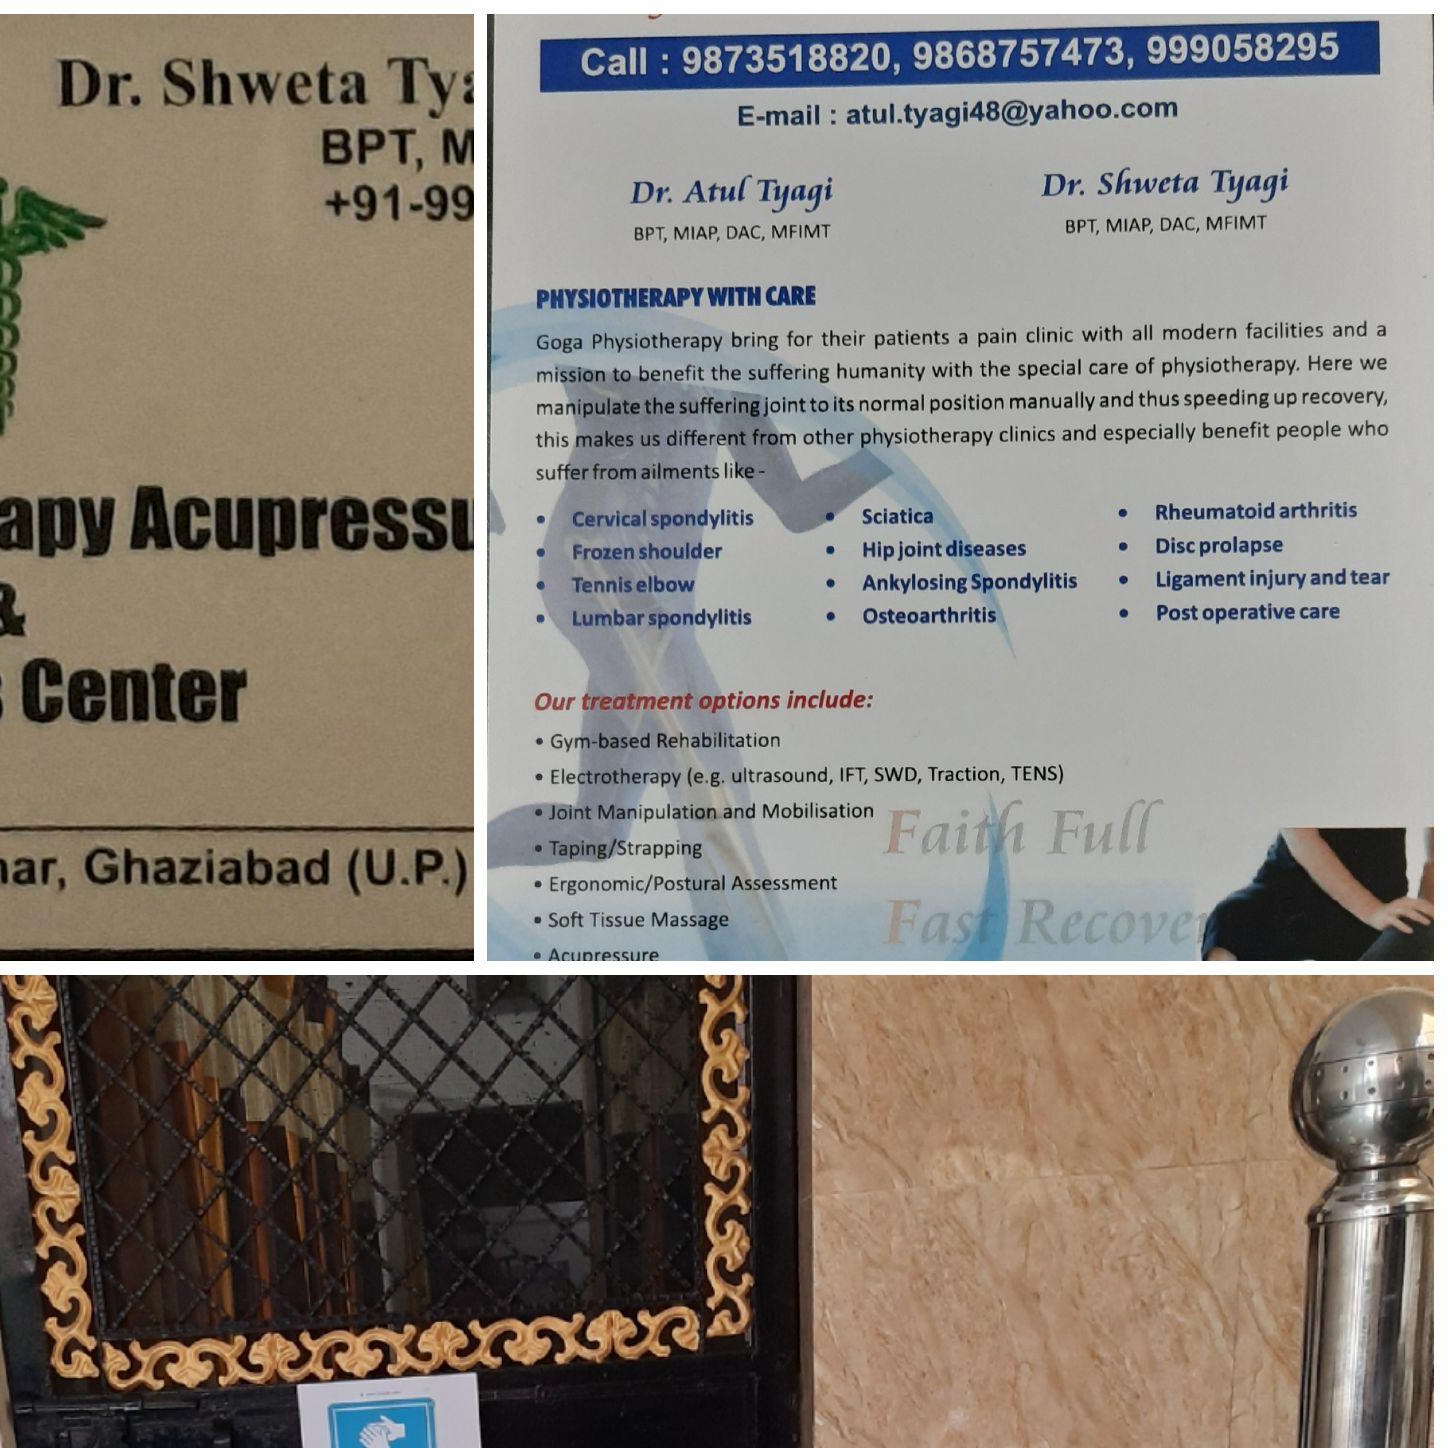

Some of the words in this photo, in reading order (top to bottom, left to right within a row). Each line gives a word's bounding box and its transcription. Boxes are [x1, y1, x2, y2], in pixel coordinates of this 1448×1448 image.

[581, 46, 646, 78] Call
[680, 41, 900, 76] 9873518820,
[913, 35, 1135, 70] 9868757473,
[1145, 30, 1339, 64] 999058295
[57, 59, 141, 107] Dr.
[163, 58, 369, 107] Shweta
[738, 104, 820, 127] E-mail
[846, 98, 1178, 129] atul.tyagi48@yahoo.com
[322, 128, 423, 173] BPT,
[630, 181, 672, 204] Dr.
[682, 174, 753, 203] Atul
[757, 176, 833, 214] Tyagi
[1041, 174, 1084, 197] Dr.
[1097, 167, 1199, 196] Shweta
[1211, 167, 1288, 203] Tyagi
[325, 184, 474, 222] +91-99
[634, 226, 667, 243] BPT,
[674, 224, 720, 243] MIAP,
[726, 224, 765, 242] DAC,
[772, 224, 831, 239] MFIMT
[1066, 217, 1099, 236] BPT,
[1106, 216, 1153, 235] MIAP,
[1160, 216, 1200, 234] DAC,
[1206, 214, 1267, 231] MFIMT
[537, 287, 704, 309] PHYSIOTHERAPY
[707, 286, 761, 307] WITH
[765, 285, 816, 306] CARE
[537, 334, 583, 354] Goga
[592, 332, 724, 353] Physiotherapy
[732, 331, 779, 351] bring
[786, 330, 813, 349] for
[820, 330, 866, 349] their
[872, 329, 949, 350] patients
[954, 332, 968, 345] a
[978, 328, 1017, 348] pain
[1026, 326, 1074, 343] clinic
[1082, 324, 1122, 344] with
[1132, 324, 1153, 344] all
[1160, 323, 1237, 344] modern
[1245, 322, 1324, 339] facilities
[1333, 320, 1367, 337] and
[1376, 325, 1387, 337] a
[536, 462, 590, 482] suffer
[592, 463, 637, 481] from
[641, 463, 720, 480] ailments
[723, 462, 755, 480] like
[573, 509, 648, 528] Cervical
[651, 508, 754, 530] spondylitis
[862, 507, 934, 525] Sciatica
[1156, 501, 1275, 520] Rheumatoid
[1279, 501, 1357, 519] arthritis
[573, 544, 635, 562] Frozen
[639, 542, 723, 560] shoulder
[863, 541, 895, 562] Hip
[897, 540, 942, 561] joint
[946, 539, 1026, 561] diseases
[1156, 537, 1196, 554] Disc
[1199, 536, 1284, 557] prolapse
[571, 576, 632, 594] Tennis
[636, 575, 695, 593] elbow
[862, 573, 968, 595] Ankylosing
[970, 572, 1078, 594] Spondylitis
[1157, 570, 1247, 591] Ligament
[1250, 569, 1307, 590] injury
[1310, 568, 1346, 586] and
[1350, 570, 1390, 585] tear
[573, 608, 645, 627] Lumbar
[648, 607, 752, 630] spondylitis
[863, 605, 998, 624] Osteoarthritis
[1157, 604, 1198, 621] Post
[1202, 603, 1296, 624] operative
[1299, 606, 1340, 619] care
[21, 657, 248, 725] Center
[535, 692, 576, 711] Our
[582, 692, 694, 711] treatment
[697, 690, 781, 714] options
[787, 689, 873, 709] include:
[550, 732, 651, 753] Gym-based
[656, 731, 782, 748] Rehabilitation
[551, 768, 681, 788] Electrotherapy
[687, 767, 725, 787] (e.g.
[731, 766, 836, 785] ultrasound,
[840, 767, 868, 785] IFT,
[872, 765, 922, 785] SWD,
[928, 766, 1005, 784] Traction,
[1010, 764, 1063, 784] TENS)
[549, 804, 592, 820] Joint
[598, 803, 719, 823] Manipulation
[722, 802, 756, 819] and
[761, 801, 875, 820] Mobilisation
[883, 800, 1026, 855] Faith
[1047, 799, 1164, 855] Full
[548, 838, 702, 862] Taping/Strapping
[84, 846, 330, 887] Ghaziabad
[348, 843, 471, 901] (U.P.)
[550, 874, 725, 896] Ergonomic/Postural
[731, 874, 837, 893] Assessment
[548, 911, 584, 928] Soft
[589, 912, 647, 928] Tissue
[649, 912, 729, 931] Massage
[883, 899, 999, 946] Fast
